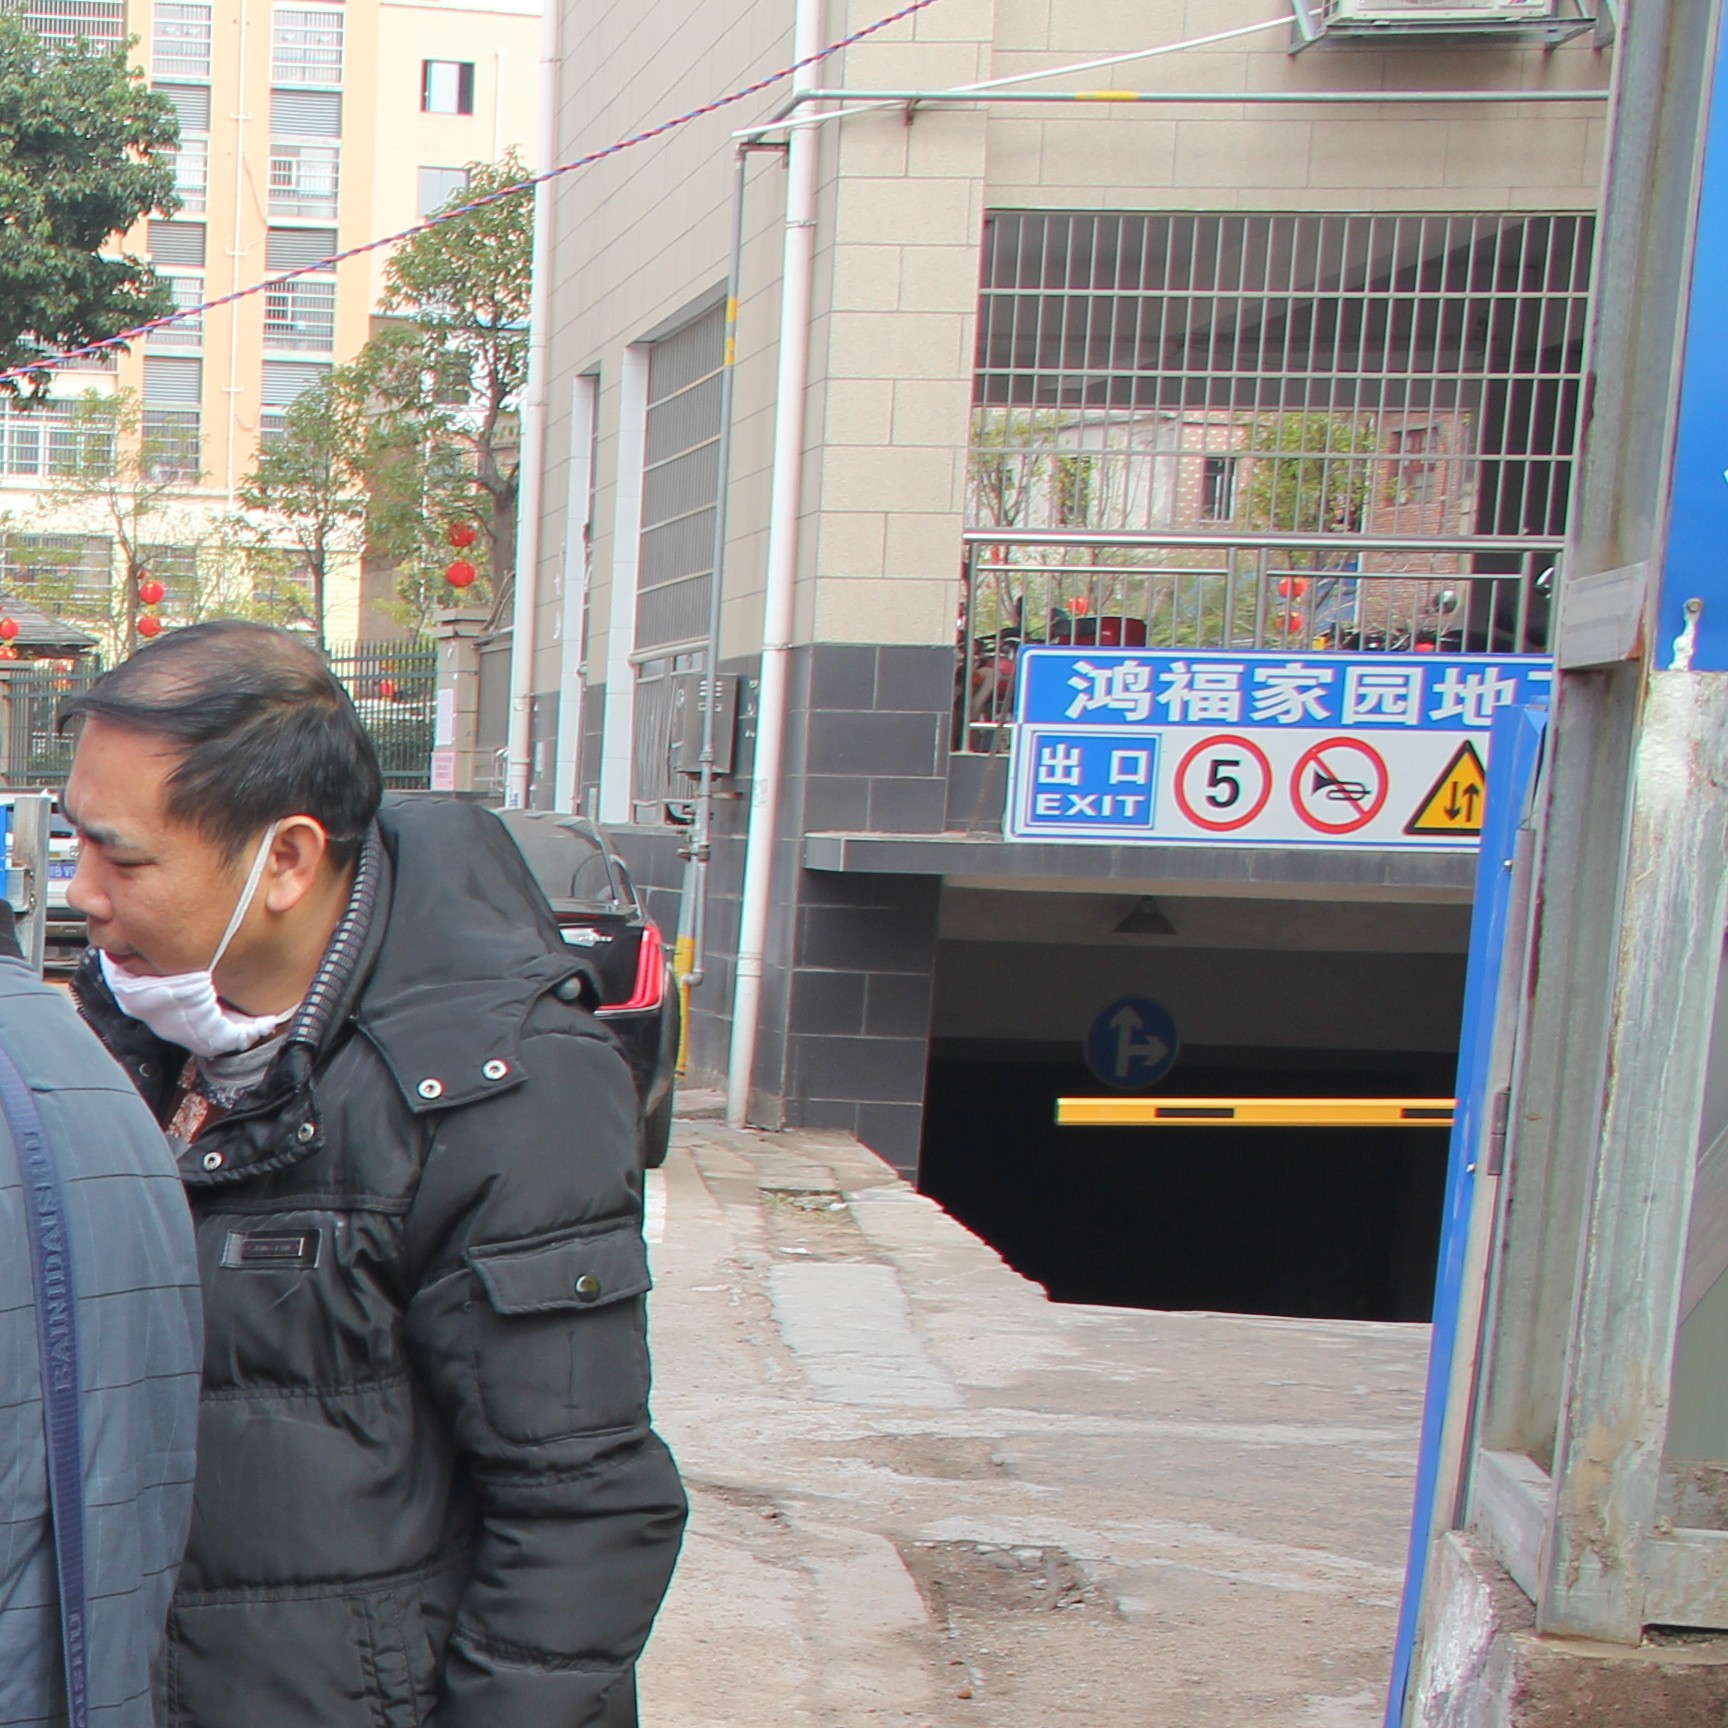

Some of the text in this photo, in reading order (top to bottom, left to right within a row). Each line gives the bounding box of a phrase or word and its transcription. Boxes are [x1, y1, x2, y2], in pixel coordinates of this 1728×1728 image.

[1064, 658, 1552, 727] 鸿福家园地
[1038, 743, 1148, 785] 出口
[1204, 759, 1242, 808] 5
[1035, 793, 1145, 817] EXIT
